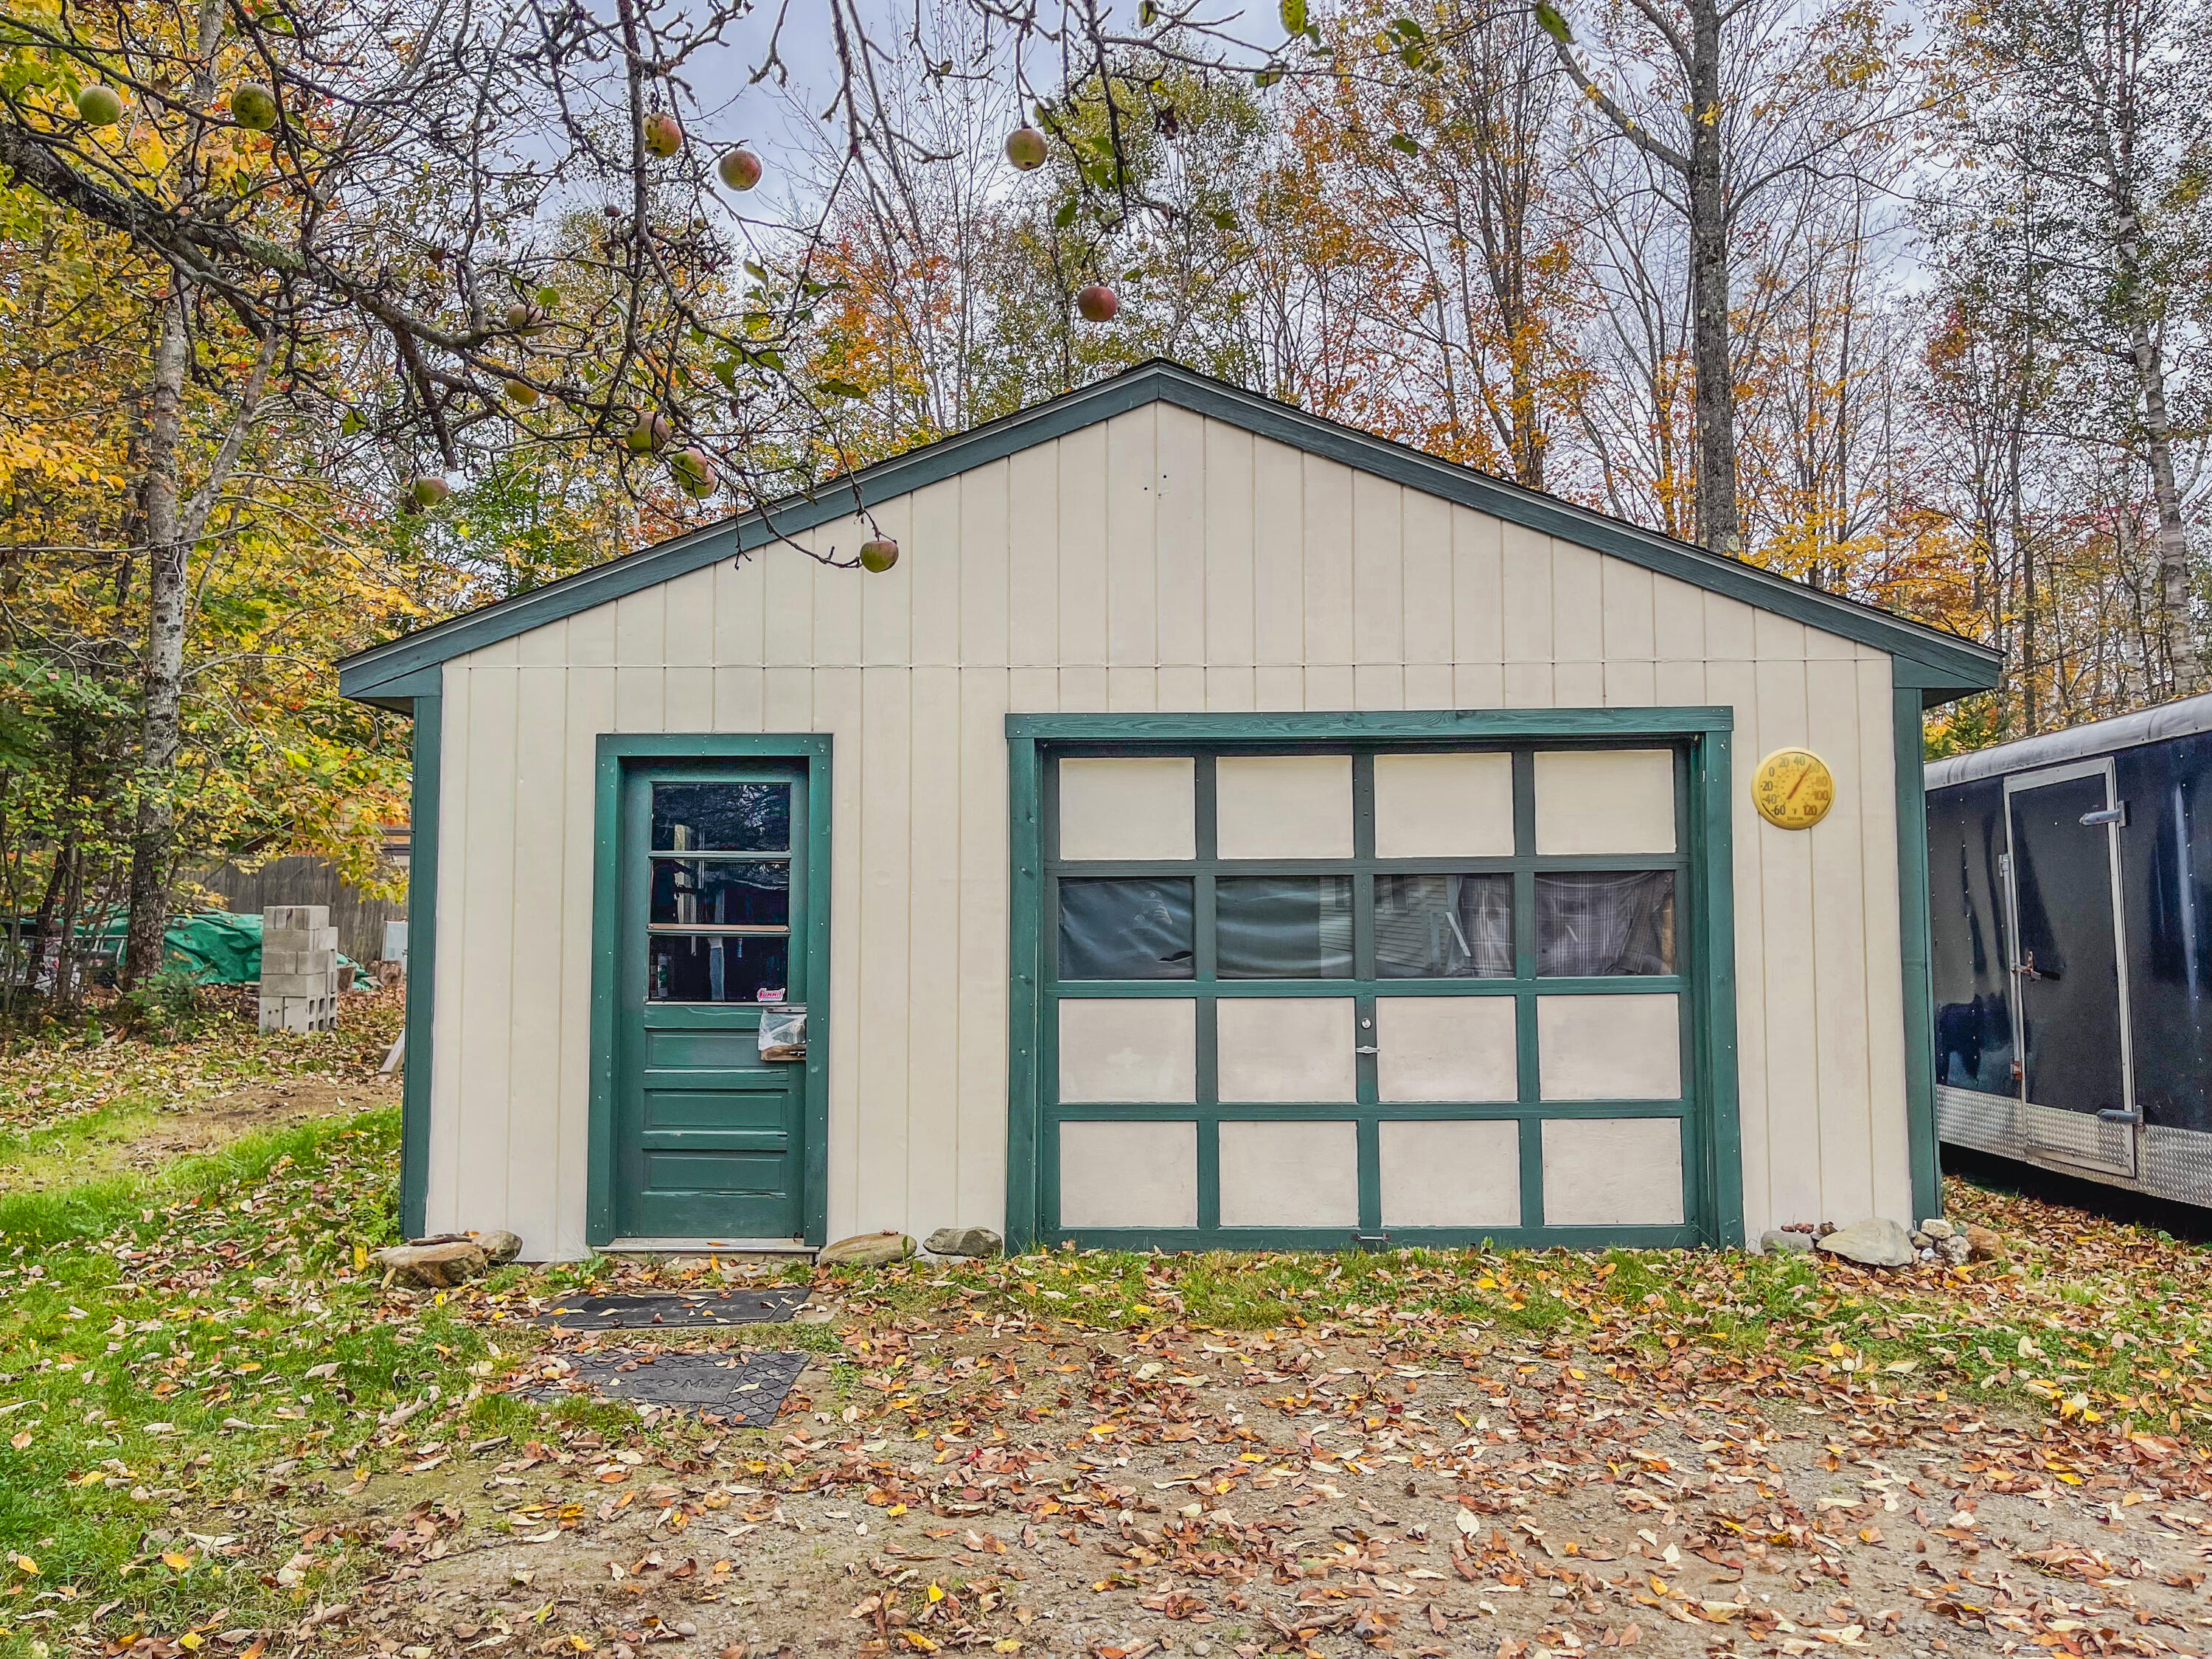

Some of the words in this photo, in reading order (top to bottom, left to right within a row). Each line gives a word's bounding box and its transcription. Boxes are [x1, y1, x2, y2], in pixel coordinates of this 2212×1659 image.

[1778, 757, 1790, 768] 20
[1793, 756, 1806, 766] 40
[1769, 766, 1775, 777] 0
[1804, 804, 1818, 815] 120
